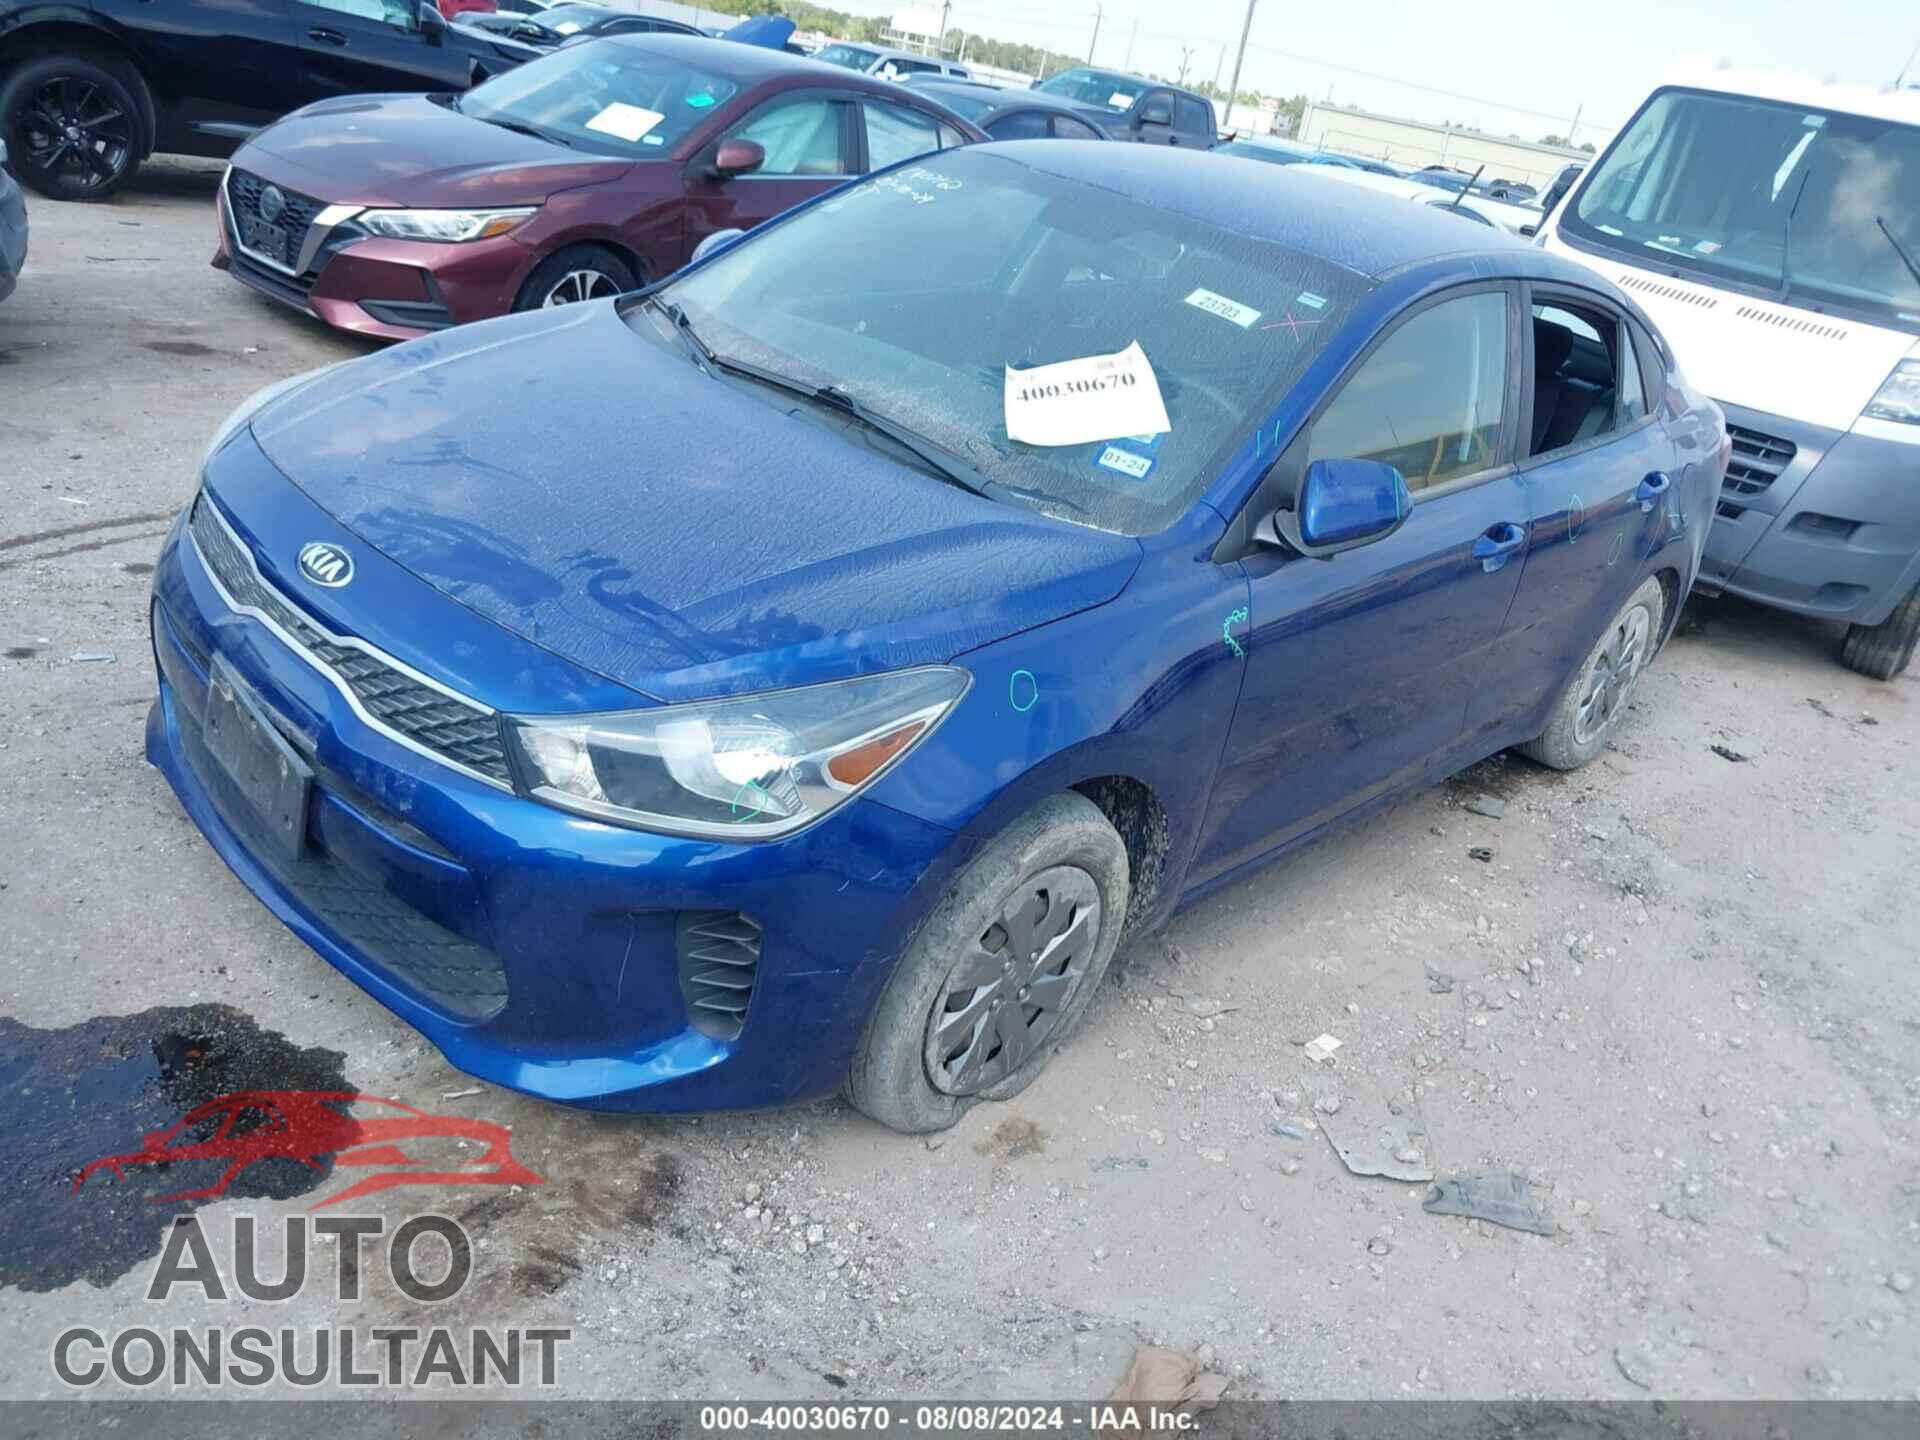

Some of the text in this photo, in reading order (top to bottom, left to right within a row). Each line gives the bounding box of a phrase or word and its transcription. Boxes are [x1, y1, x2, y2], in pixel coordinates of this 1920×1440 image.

[1198, 296, 1241, 318] 23703
[1016, 373, 1136, 402] 40030670
[302, 545, 345, 582] KIA
